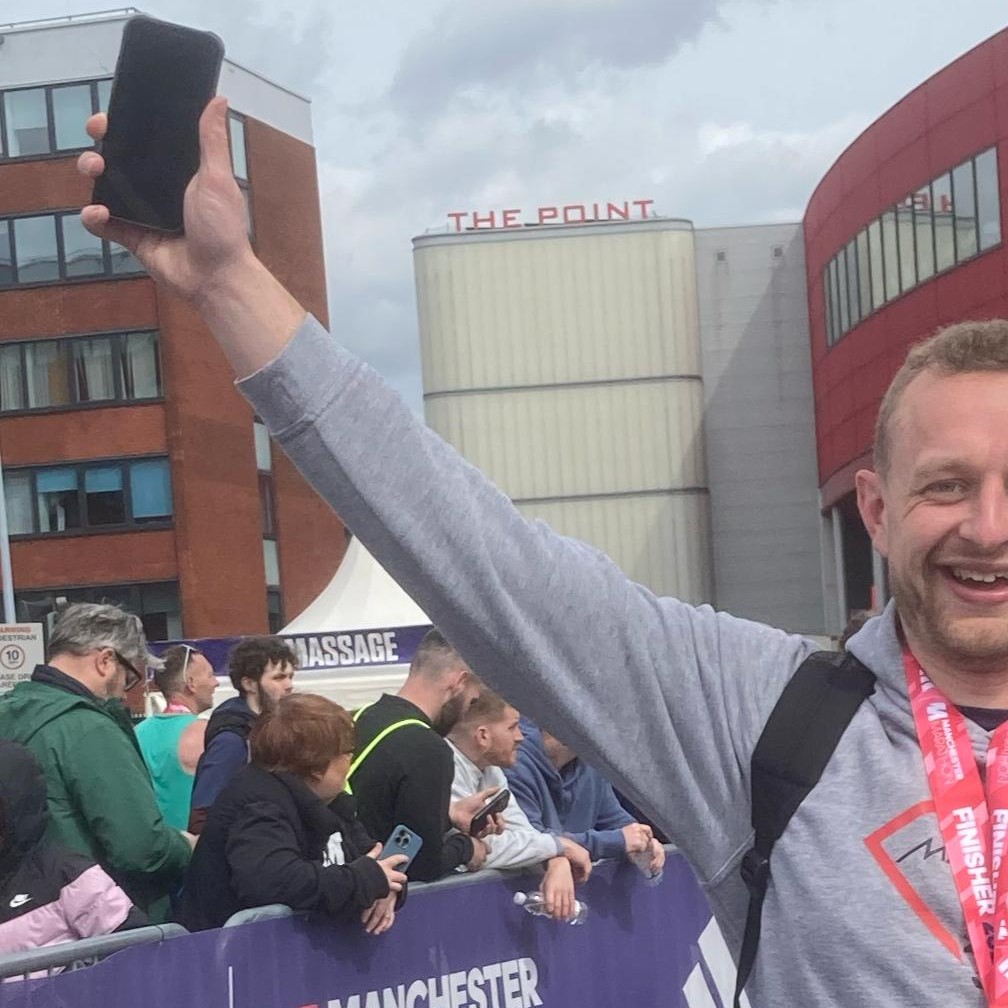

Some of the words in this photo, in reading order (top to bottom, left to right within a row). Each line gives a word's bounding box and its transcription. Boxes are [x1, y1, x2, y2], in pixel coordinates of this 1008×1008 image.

[447, 209, 523, 232] THE
[538, 200, 653, 226] POINT
[6, 650, 19, 661] 10
[285, 632, 399, 668] MASSAGE
[952, 807, 996, 917] FINISHER
